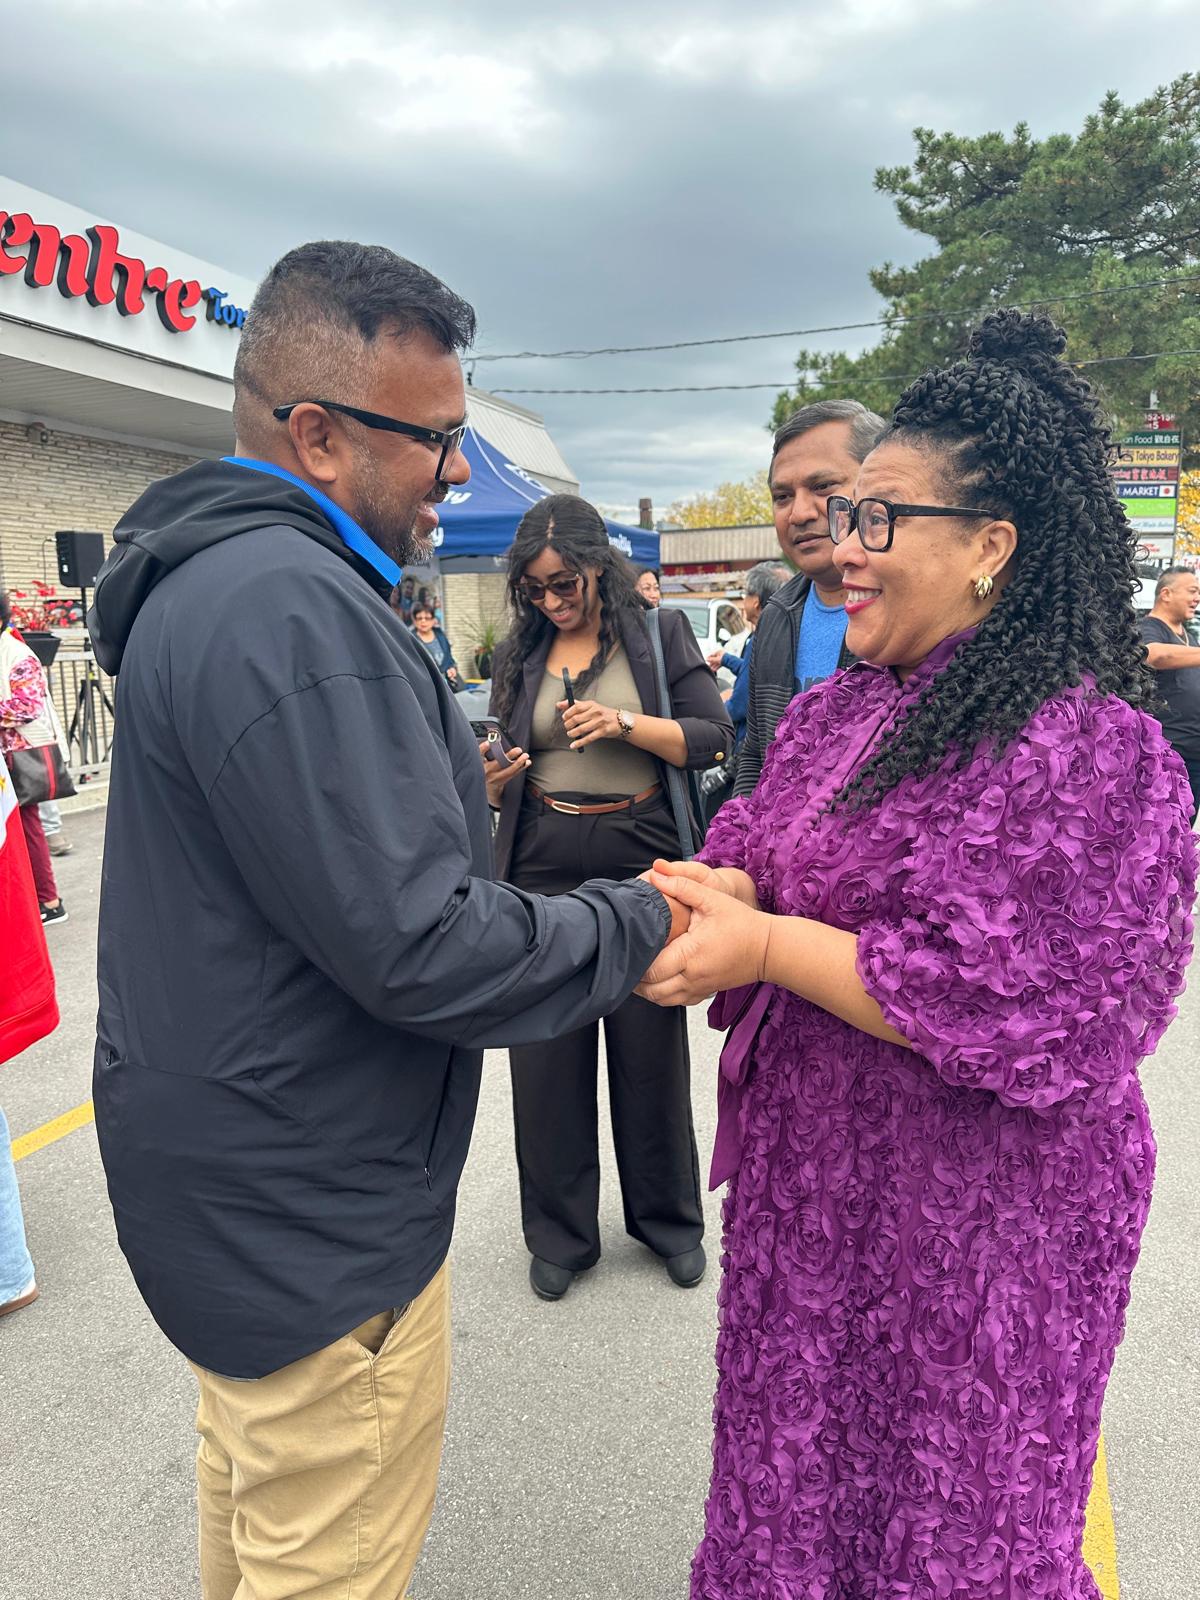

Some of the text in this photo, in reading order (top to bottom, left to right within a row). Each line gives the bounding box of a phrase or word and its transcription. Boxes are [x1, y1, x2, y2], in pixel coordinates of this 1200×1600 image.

[1134, 435, 1153, 444] Food
[1136, 450, 1155, 464] Tokyo
[1156, 450, 1179, 462] Bakery
[1123, 486, 1159, 496] MARKET
